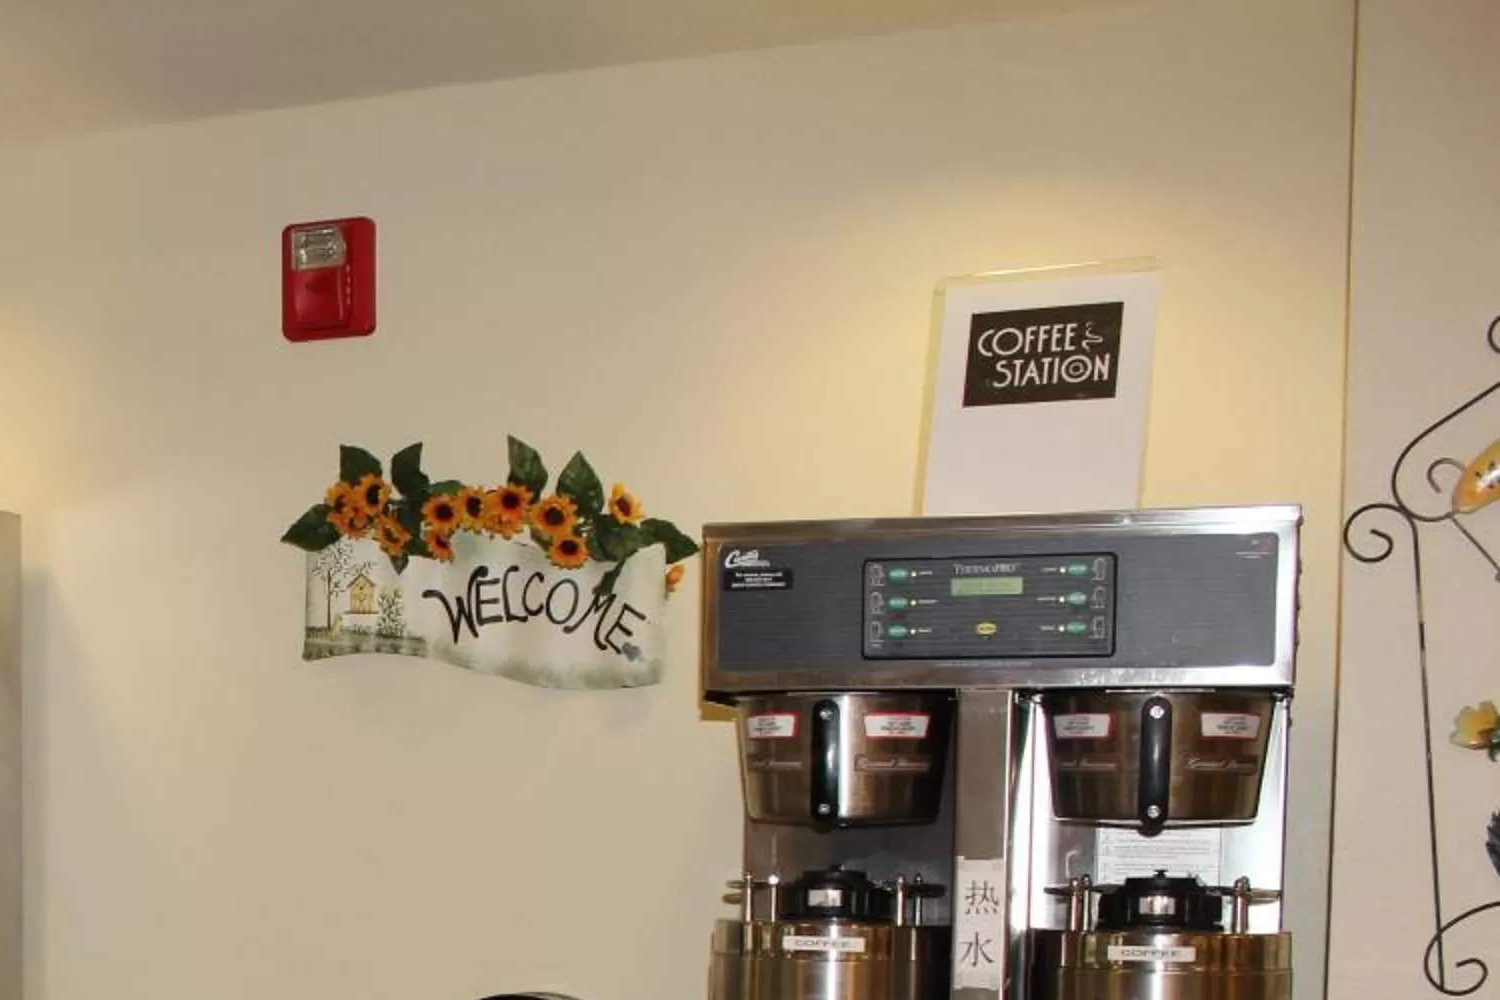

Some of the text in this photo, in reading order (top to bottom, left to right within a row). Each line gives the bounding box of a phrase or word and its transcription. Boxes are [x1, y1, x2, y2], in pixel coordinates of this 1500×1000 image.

[977, 322, 1078, 357] COFFEE
[992, 353, 1111, 388] STATION
[422, 566, 647, 654] WELCOME
[960, 880, 999, 968] 热水
[795, 938, 857, 948] COFFEE
[1121, 948, 1182, 957] COFFEE
